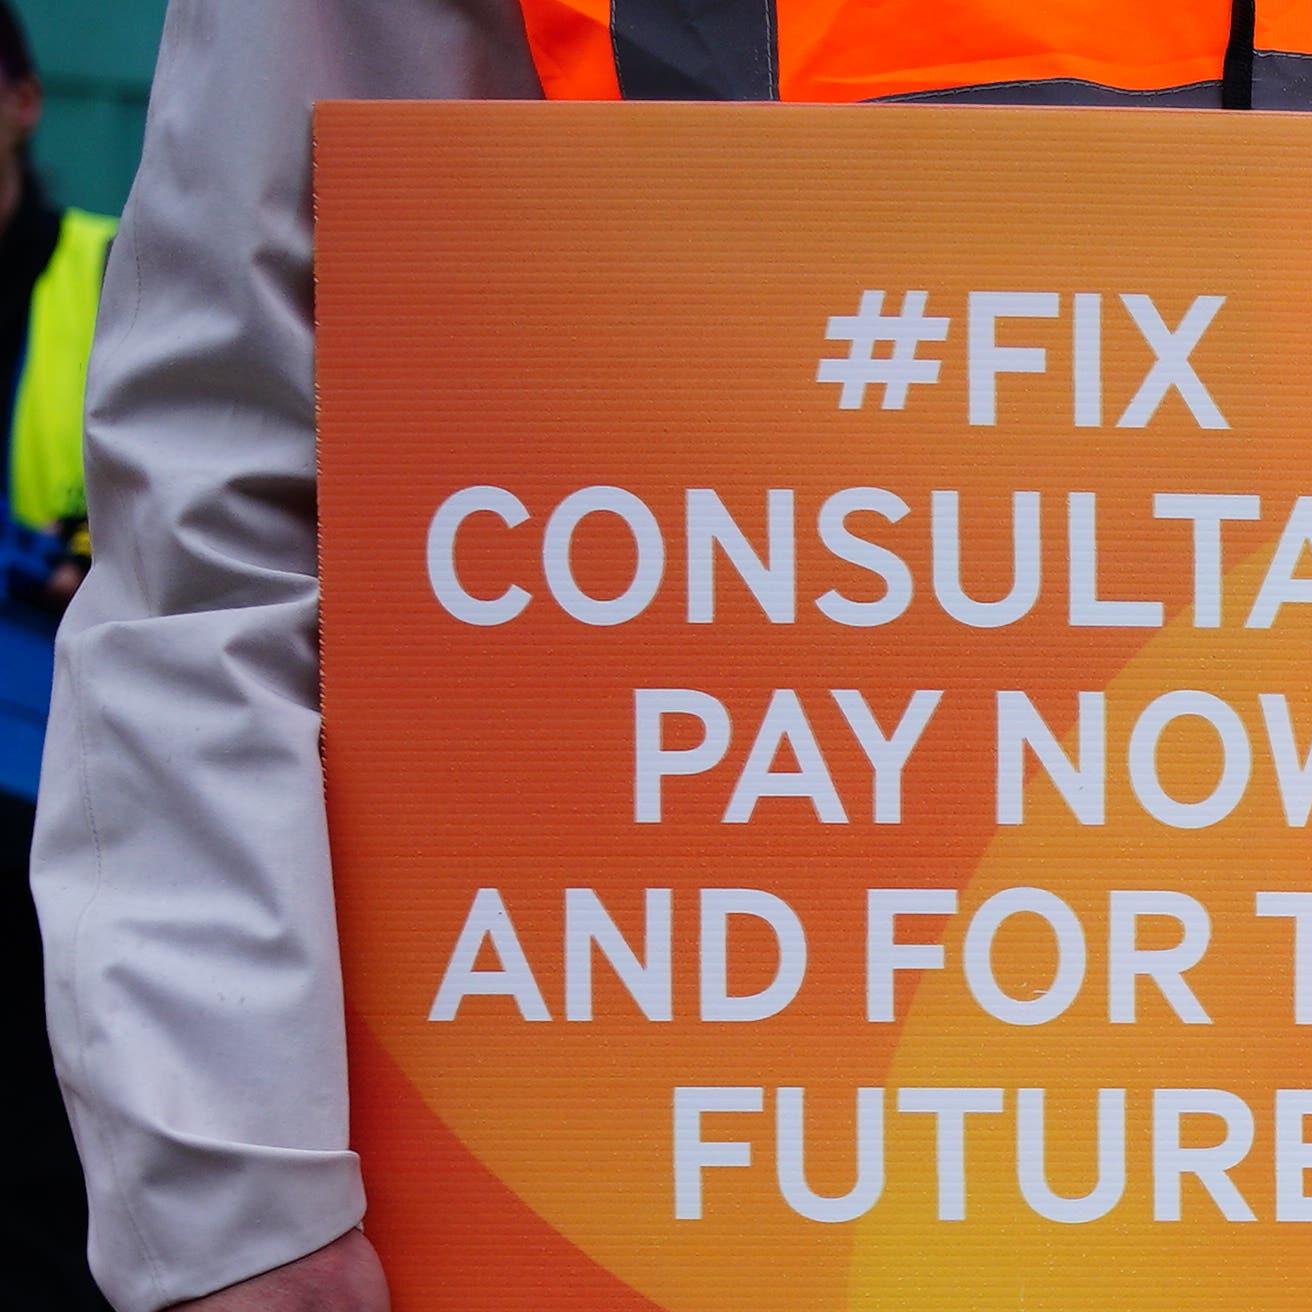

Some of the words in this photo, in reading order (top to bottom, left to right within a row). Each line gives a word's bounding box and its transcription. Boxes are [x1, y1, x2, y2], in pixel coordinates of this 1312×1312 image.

[817, 290, 1229, 430] #FIX
[635, 688, 944, 824] PAY
[428, 887, 806, 1022] AND
[866, 886, 1213, 1026] FOR
